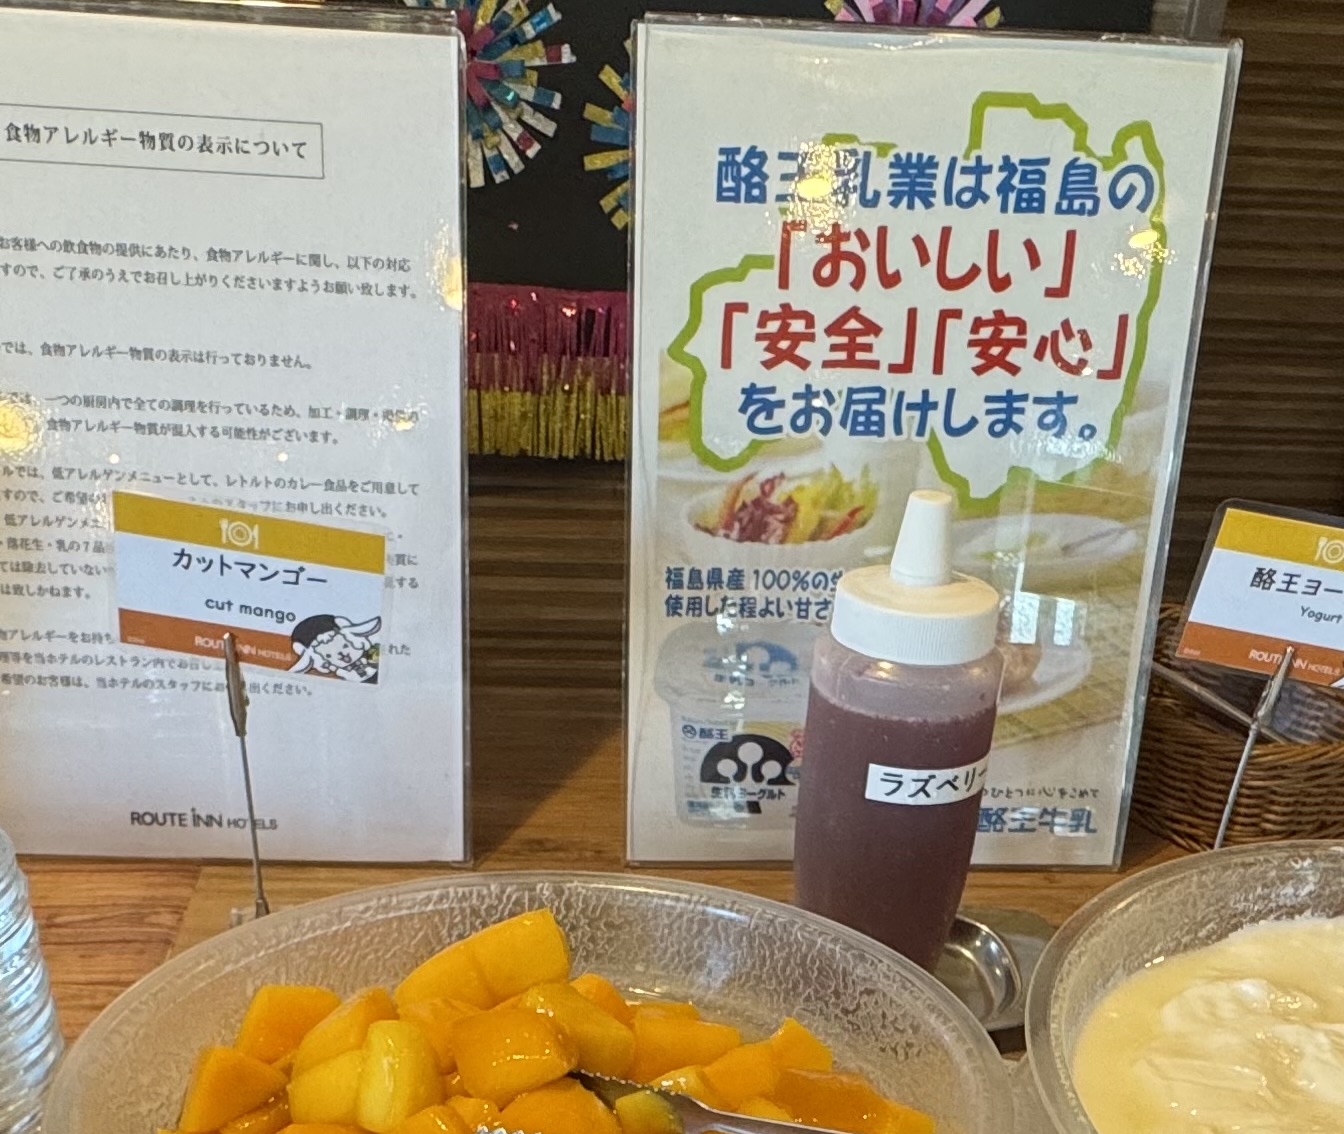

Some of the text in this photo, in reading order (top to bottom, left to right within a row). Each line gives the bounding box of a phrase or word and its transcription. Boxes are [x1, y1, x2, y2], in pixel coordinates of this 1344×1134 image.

[4, 121, 309, 160] 食物アレルギー物質の表示について
[777, 219, 1077, 299] 「おいしい」
[719, 301, 1130, 381] 「安全」「安心」
[737, 381, 1099, 441] をお届けします。
[172, 547, 329, 586] カットマンゴー
[204, 597, 297, 624] cut mango
[1299, 605, 1344, 625] Yogurt
[194, 634, 224, 651] ROUT
[130, 811, 188, 828] ROUTE
[227, 817, 279, 831] HOELS
